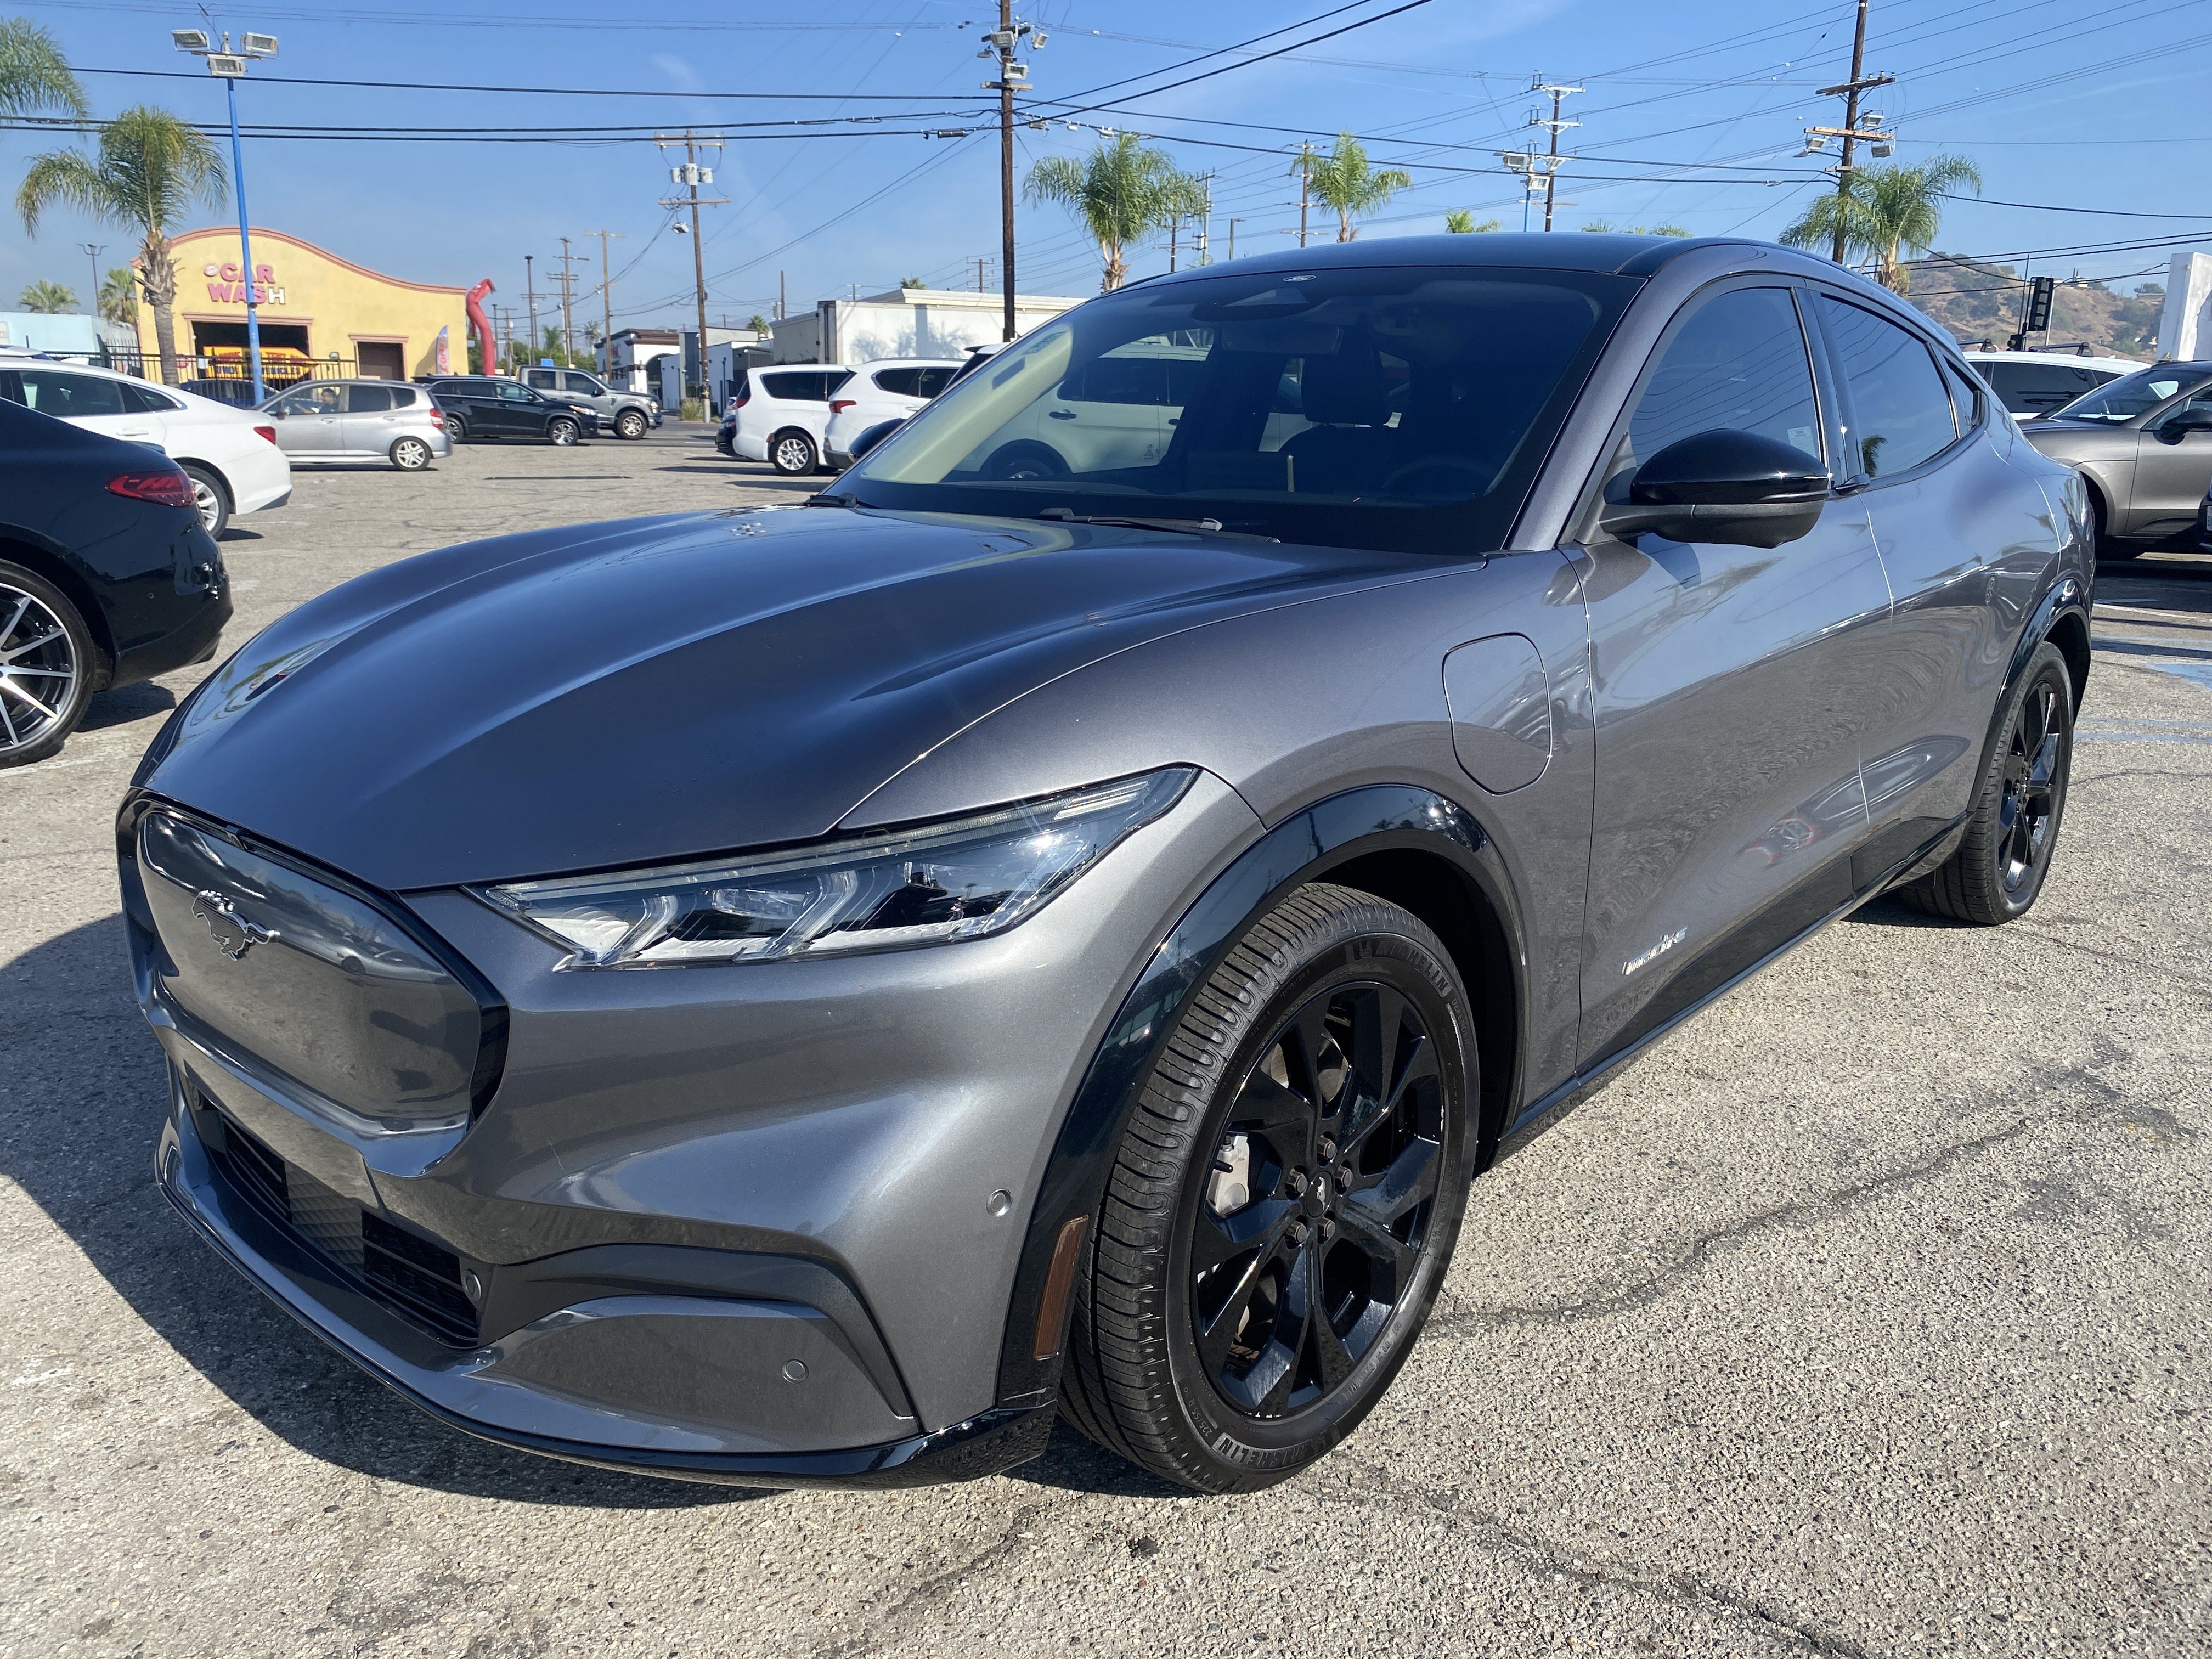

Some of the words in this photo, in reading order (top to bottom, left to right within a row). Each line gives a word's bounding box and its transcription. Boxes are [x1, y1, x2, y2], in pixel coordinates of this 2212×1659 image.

[208, 283, 285, 304] WASH
[1451, 998, 1470, 1046] DEFENDER
[1188, 1398, 1195, 1407] R
[1192, 1407, 1212, 1437] 225/55
